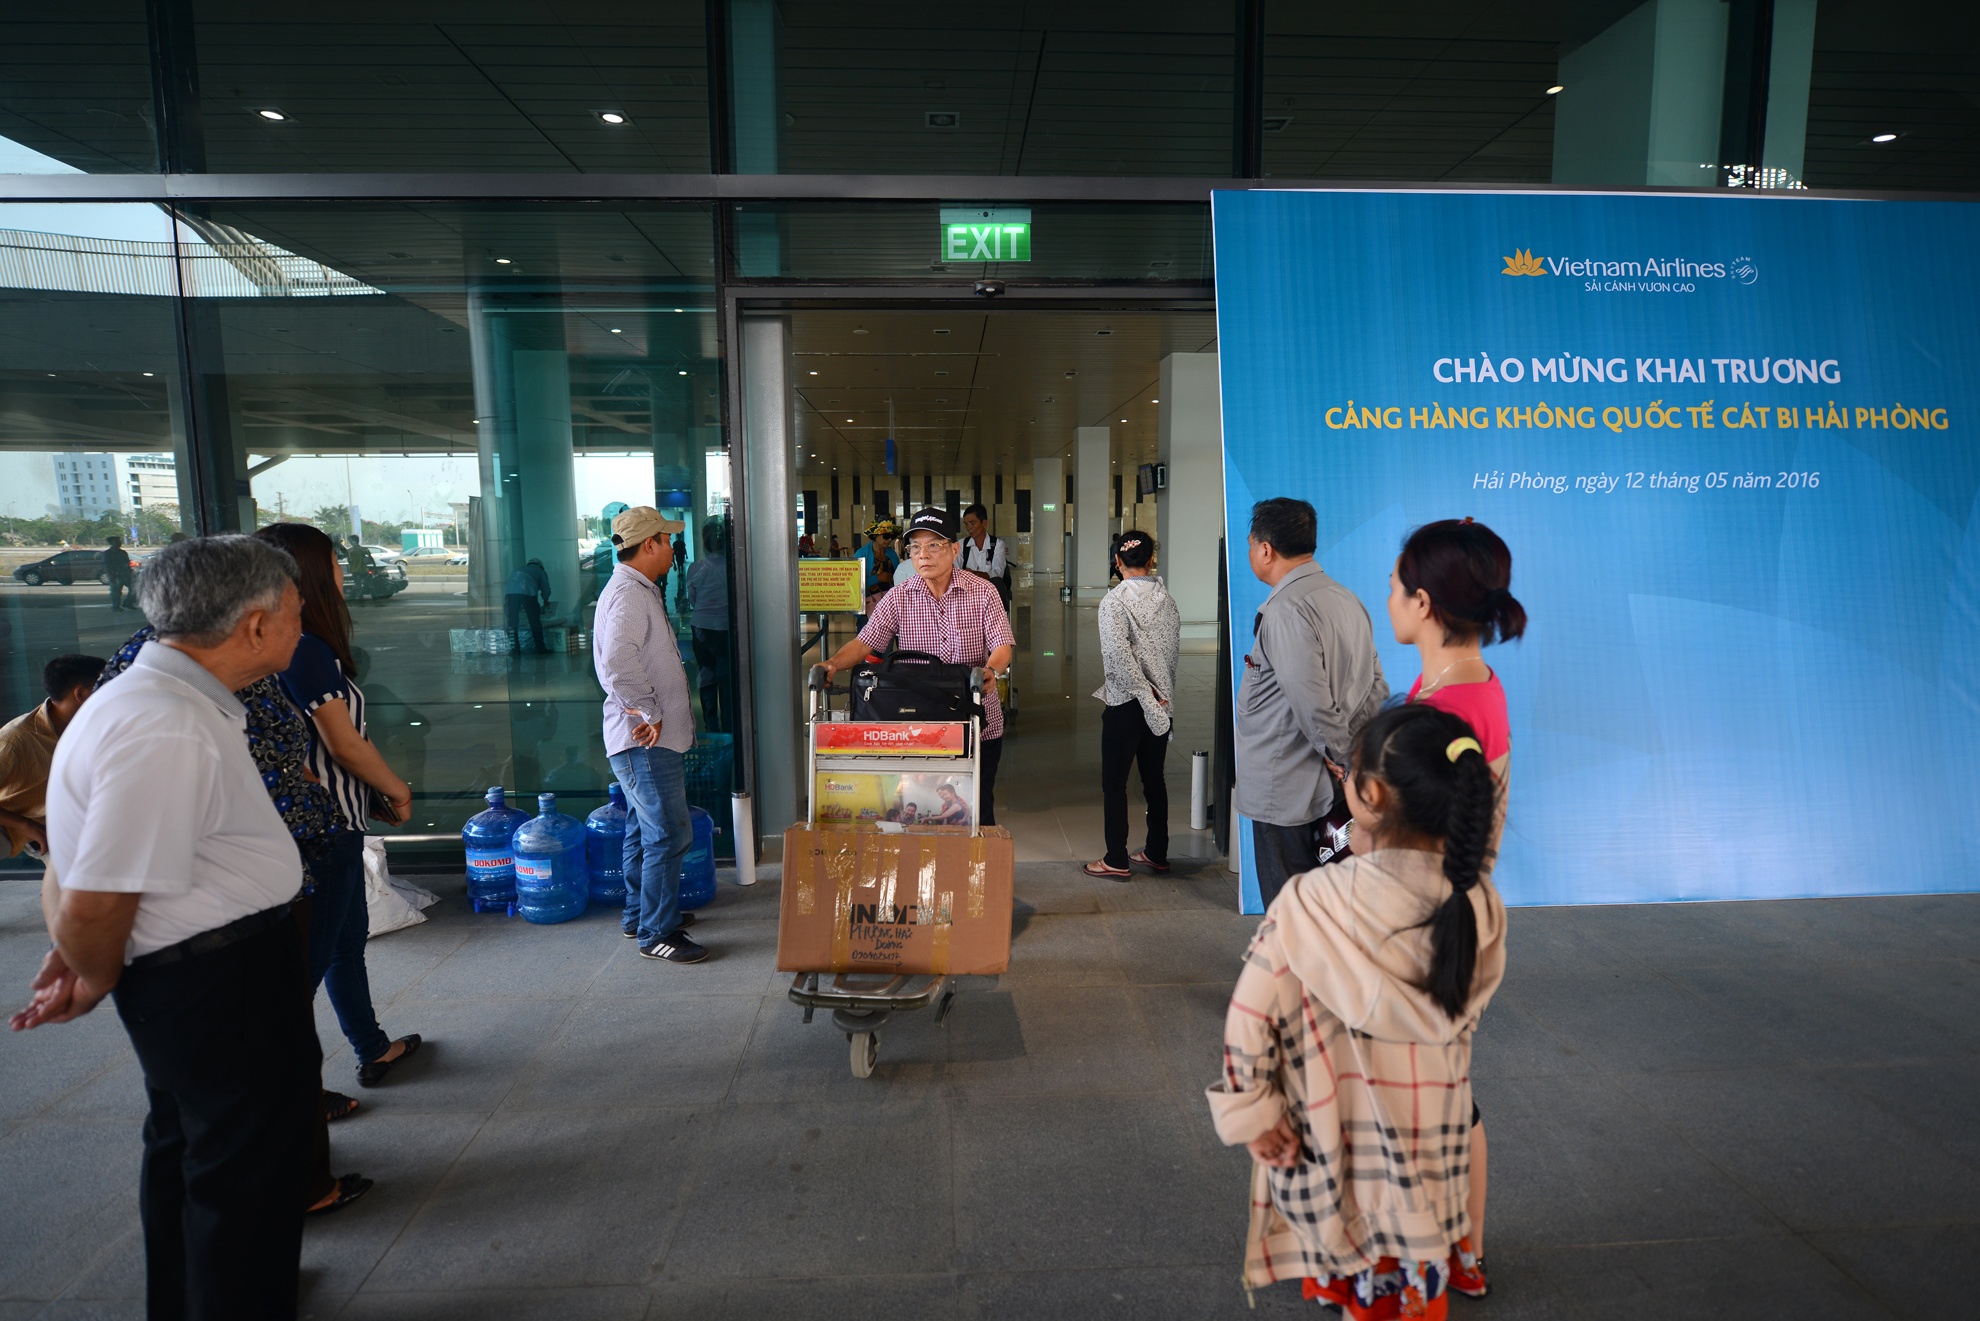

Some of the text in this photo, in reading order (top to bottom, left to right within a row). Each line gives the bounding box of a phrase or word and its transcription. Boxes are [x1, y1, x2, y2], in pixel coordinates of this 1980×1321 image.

[947, 226, 1025, 259] EXIT
[1547, 256, 1726, 278] Vietnam Airlines
[1730, 256, 1751, 279] SKYTEAM
[1604, 279, 1636, 292] CÁNH
[1672, 282, 1695, 293] CAO
[1433, 352, 1841, 384] CHÀO MỪNG KHAI TRƯƠNG
[1325, 399, 1949, 433] CẢNG HÀNG KHÔNG QUỐC TẾ CÁT BI HẢI PHÒNG
[1472, 470, 1820, 494] Hải Phòng, ngày 12 tháng 05 năm 2016
[863, 730, 910, 741] HDBank
[474, 857, 512, 867] DOKOMO
